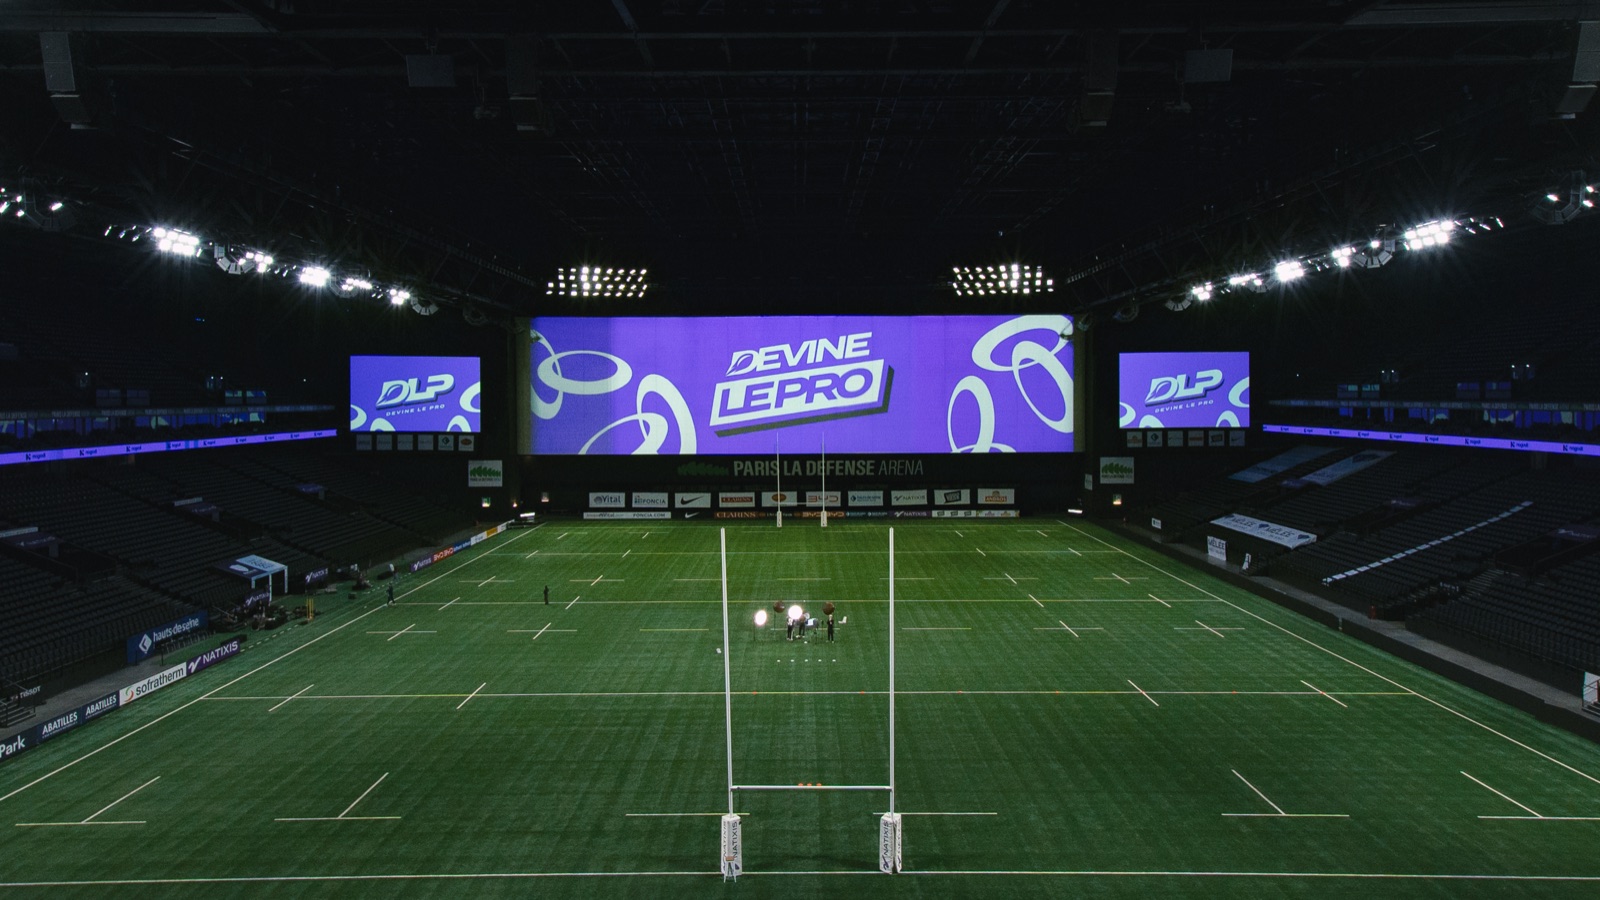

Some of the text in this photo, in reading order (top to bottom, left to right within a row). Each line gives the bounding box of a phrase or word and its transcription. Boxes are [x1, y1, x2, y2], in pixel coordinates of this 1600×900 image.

[726, 332, 872, 377] DEVINE
[376, 373, 455, 408] DLP
[1145, 369, 1223, 404] DLP
[386, 408, 415, 417] DEVINE
[429, 403, 445, 411] PRO
[1154, 404, 1183, 414] DEVINE
[733, 459, 924, 476] PARIS LA DEFENSE ARENA
[202, 640, 239, 664] NATIXIS
[19, 685, 41, 699] TISSOT
[136, 667, 184, 696] sofratherm
[85, 694, 117, 716] ABATILLES
[41, 711, 78, 735] ABATILLES
